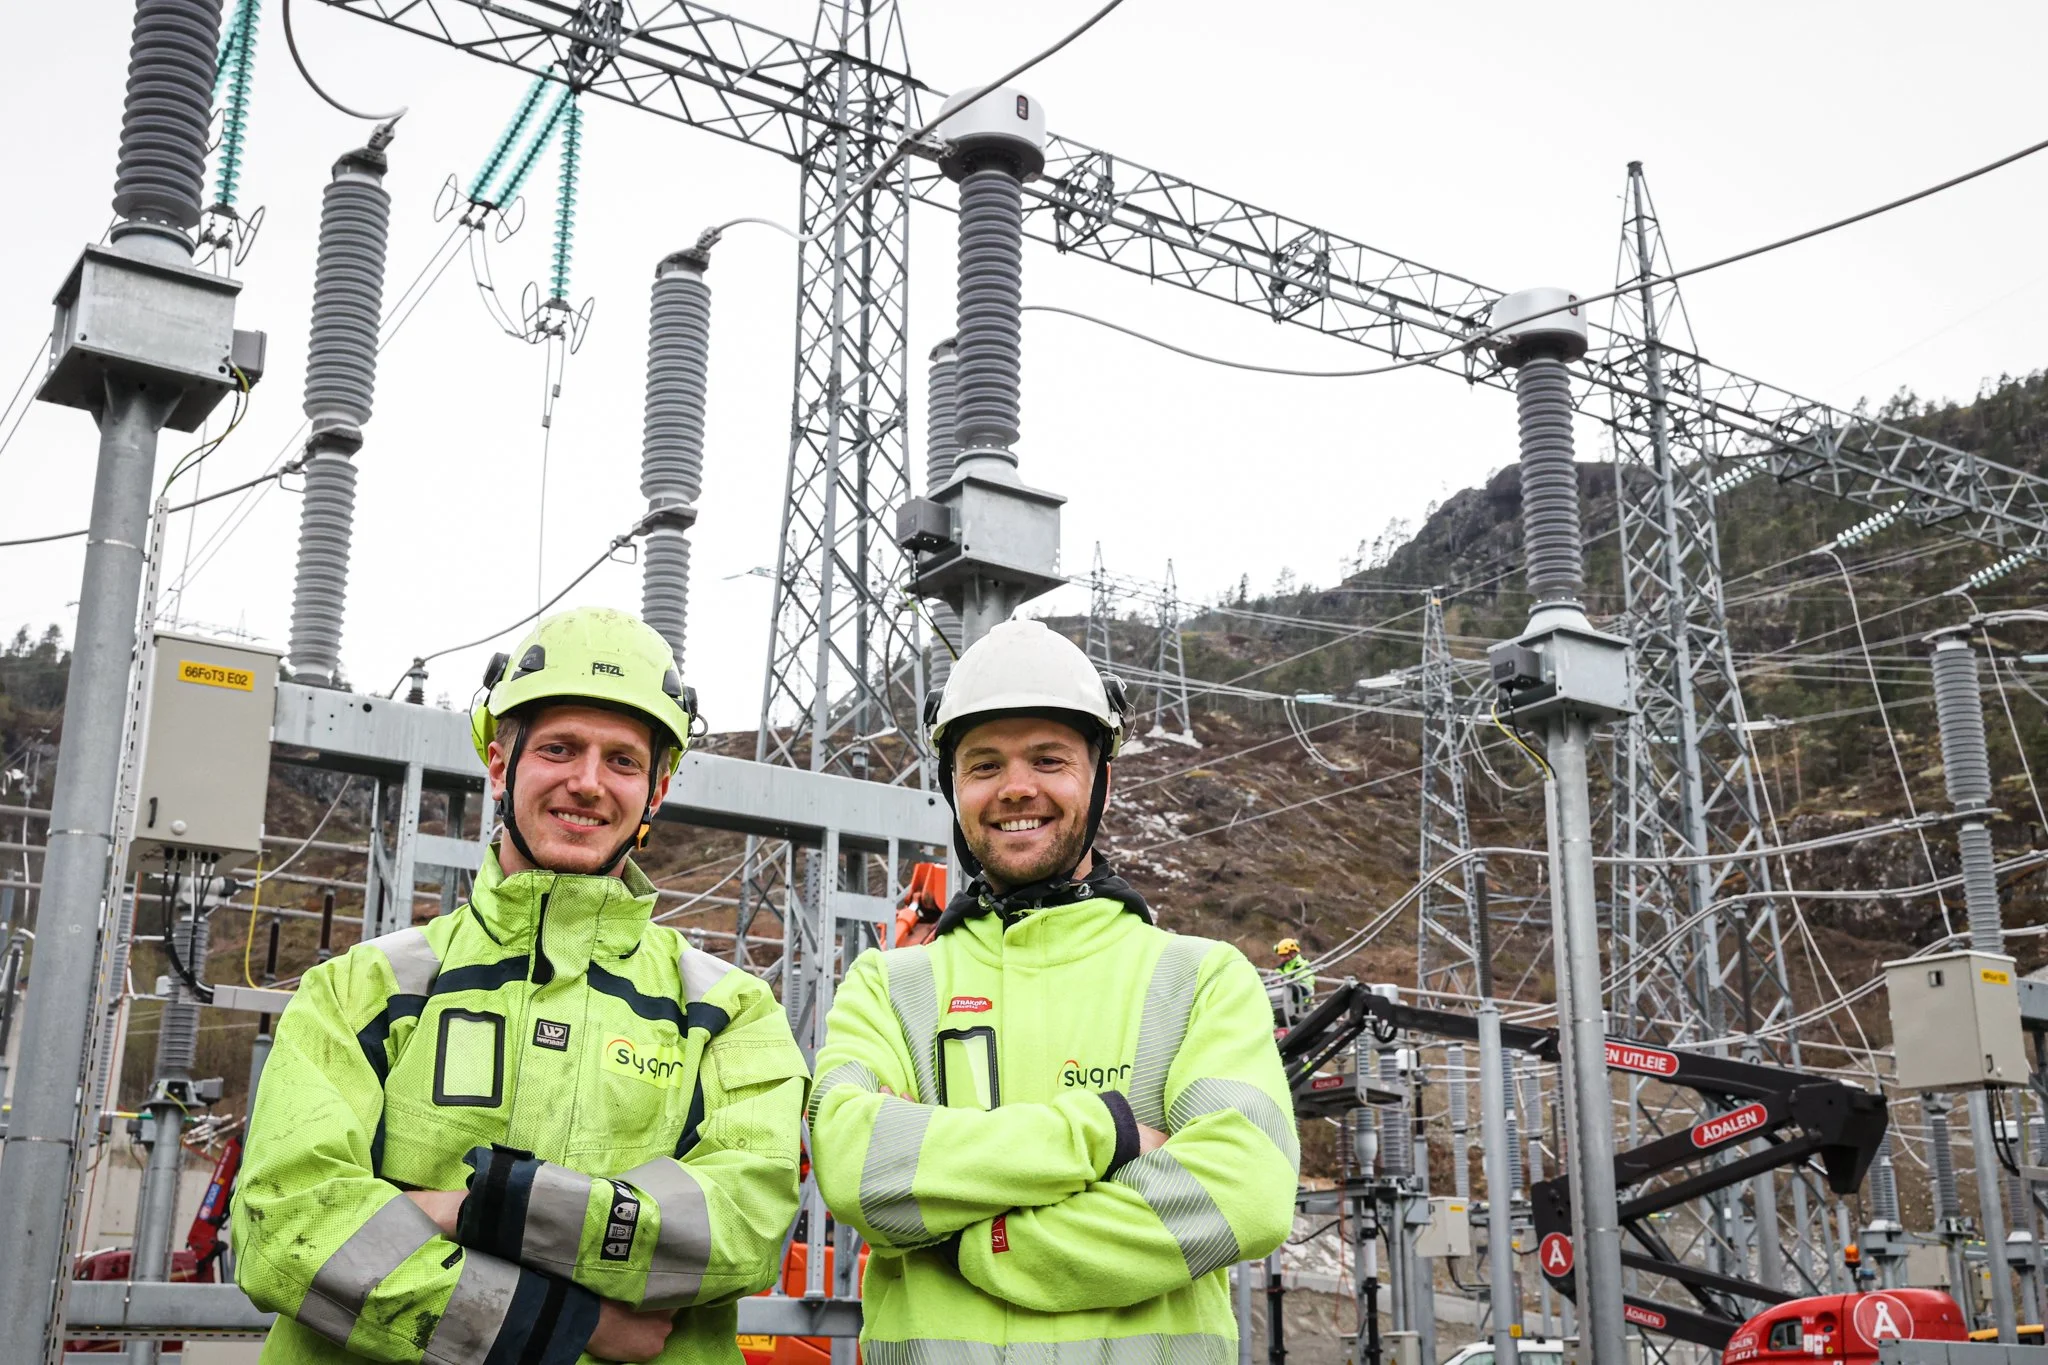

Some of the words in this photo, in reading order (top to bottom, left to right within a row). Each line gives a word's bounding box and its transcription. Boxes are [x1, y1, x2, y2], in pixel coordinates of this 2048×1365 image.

[592, 662, 624, 676] PETZL
[227, 672, 248, 686] E02
[1623, 1050, 1668, 1071] UTLEIE
[1702, 1110, 1758, 1143] ÅDALEN
